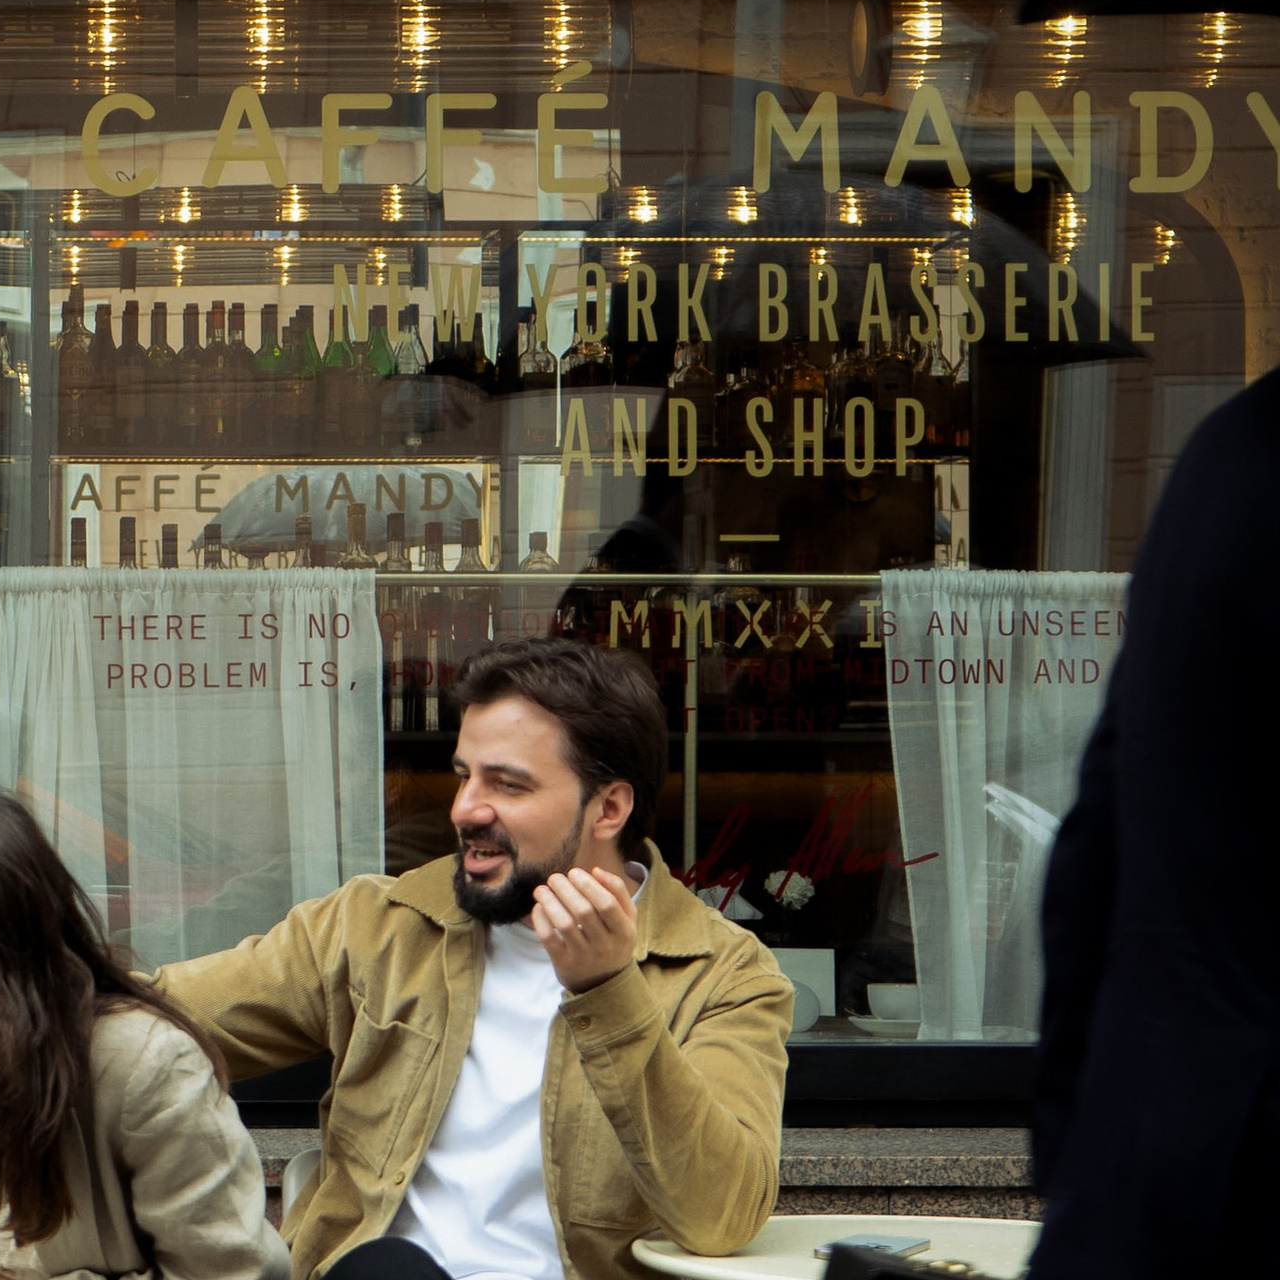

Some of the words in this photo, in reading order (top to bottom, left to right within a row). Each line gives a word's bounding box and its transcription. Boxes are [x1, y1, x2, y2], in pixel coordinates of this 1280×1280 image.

[81, 60, 609, 197] CAFFÉ
[333, 262, 483, 343] NEW
[526, 262, 712, 343] YORK
[758, 262, 1156, 343] BRASSERIE
[559, 397, 699, 477] AND
[746, 397, 927, 478] SHOP
[70, 465, 221, 513] AFFÉ
[93, 613, 208, 641] THERE
[237, 613, 280, 640] IS
[308, 612, 352, 640] NO
[927, 610, 968, 637] AN
[609, 600, 882, 648] MMXXI
[107, 661, 267, 689] PROBLEM
[298, 661, 359, 694] IS,
[725, 658, 815, 685] FROM
[843, 658, 1004, 685] MIDTOWN
[1034, 658, 1100, 684] AND
[724, 706, 839, 733] OPEN?
